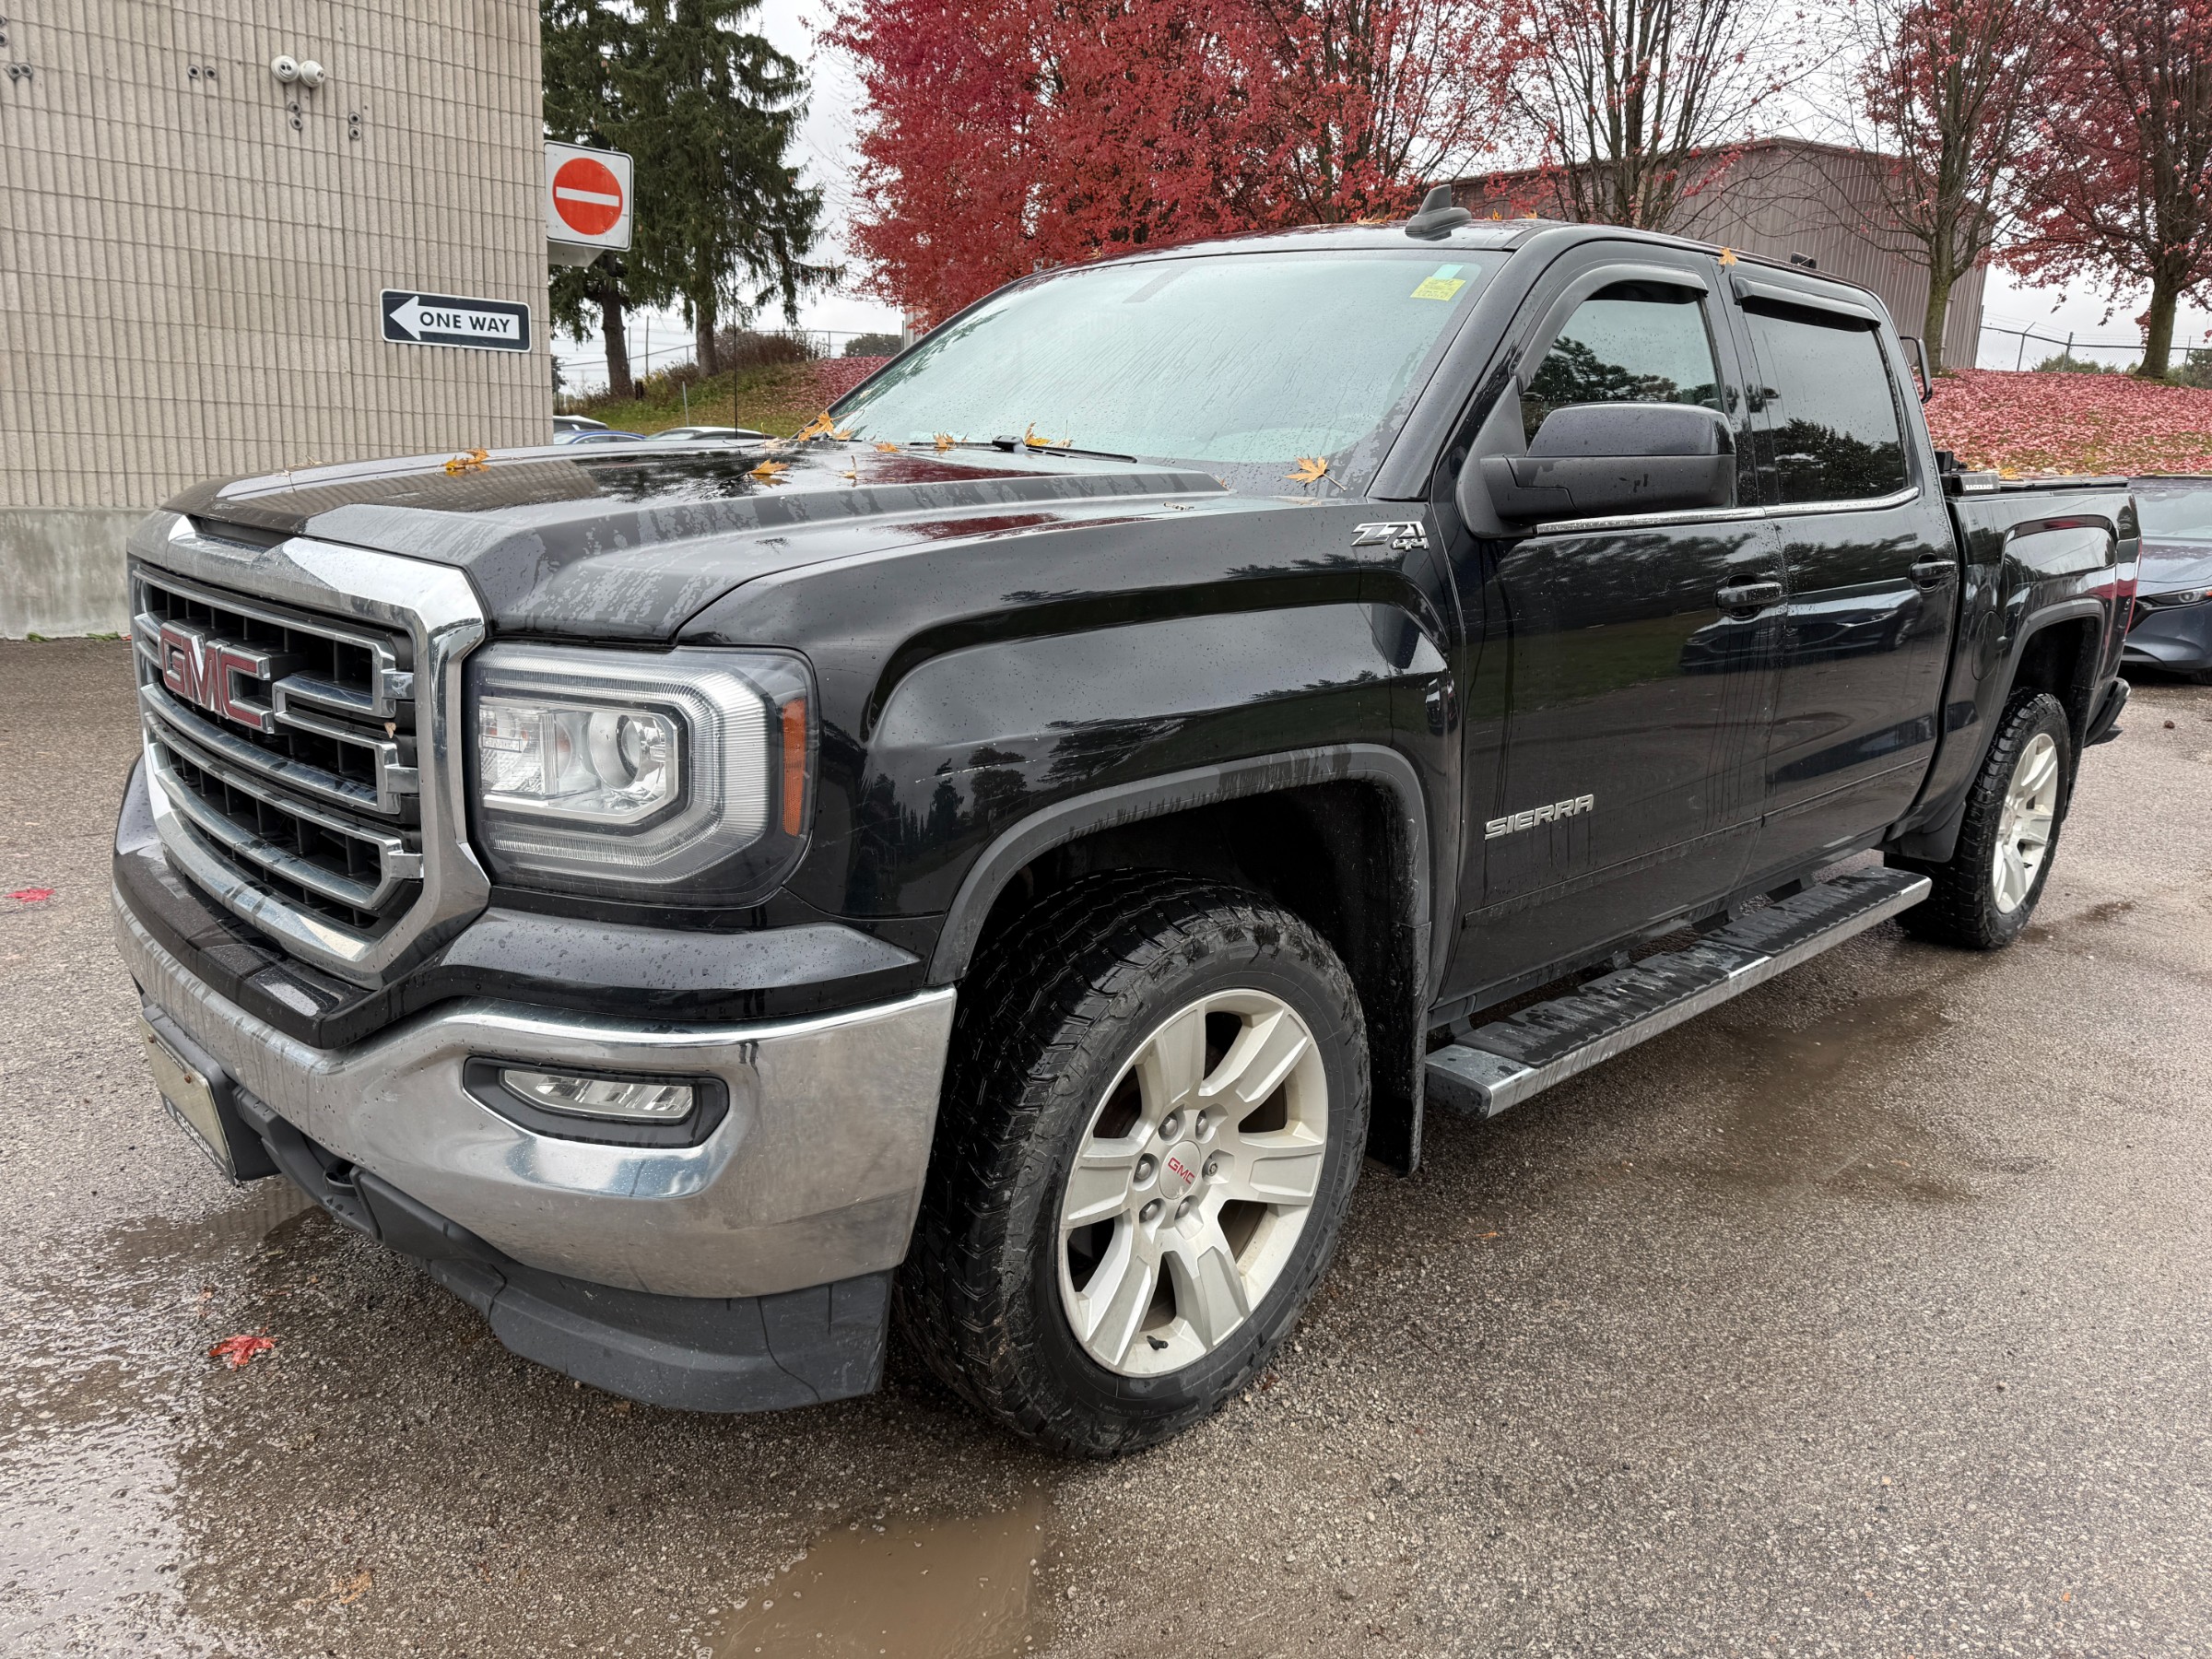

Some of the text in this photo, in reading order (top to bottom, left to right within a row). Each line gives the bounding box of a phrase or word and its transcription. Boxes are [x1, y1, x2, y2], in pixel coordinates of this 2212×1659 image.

[419, 312, 510, 333] ONE WAY
[1351, 521, 1426, 546] Z71
[159, 621, 275, 734] GMC
[1484, 794, 1594, 841] SIERRA
[1168, 1157, 1195, 1185] GMC
